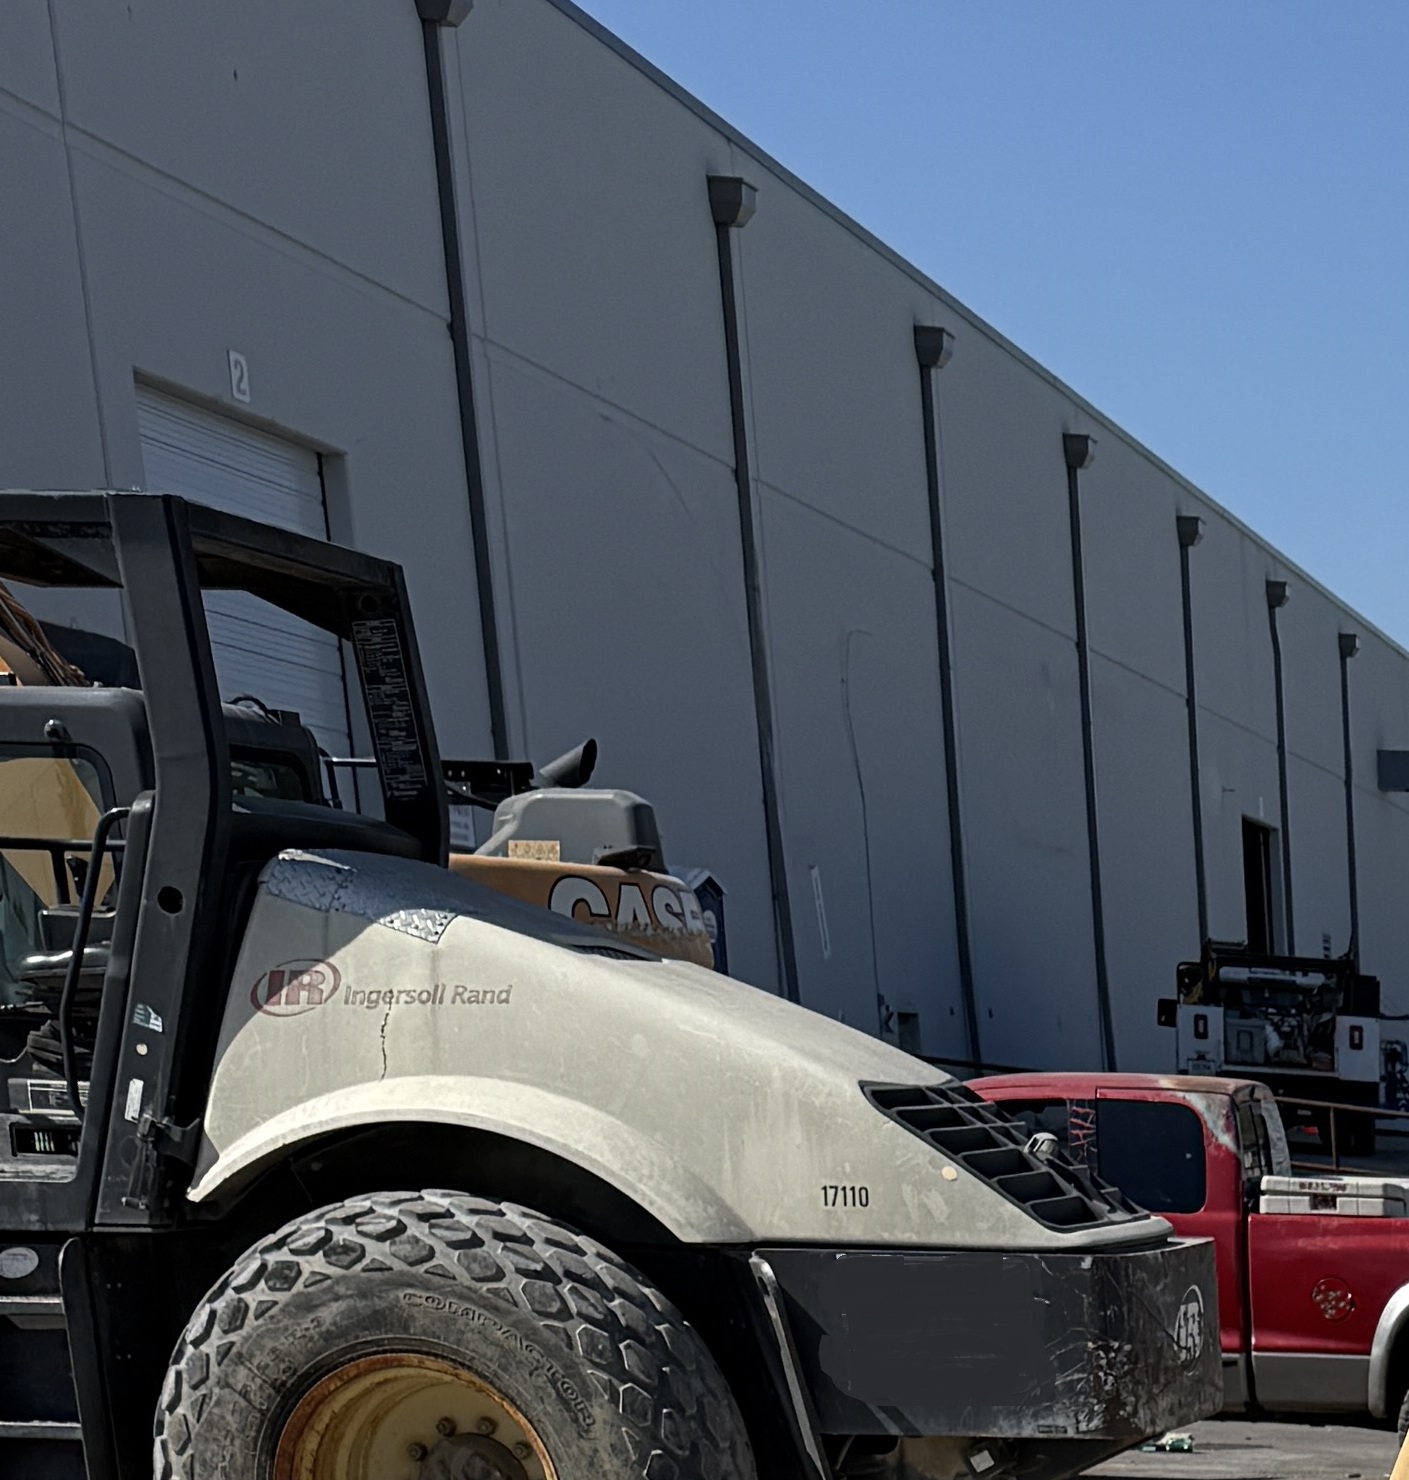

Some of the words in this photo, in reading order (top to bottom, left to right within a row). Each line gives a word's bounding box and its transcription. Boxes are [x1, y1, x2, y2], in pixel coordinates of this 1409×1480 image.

[234, 358, 248, 396] 2
[343, 983, 447, 1010] Ingersoll
[450, 984, 514, 1006] Rand
[821, 1185, 870, 1208] 17110
